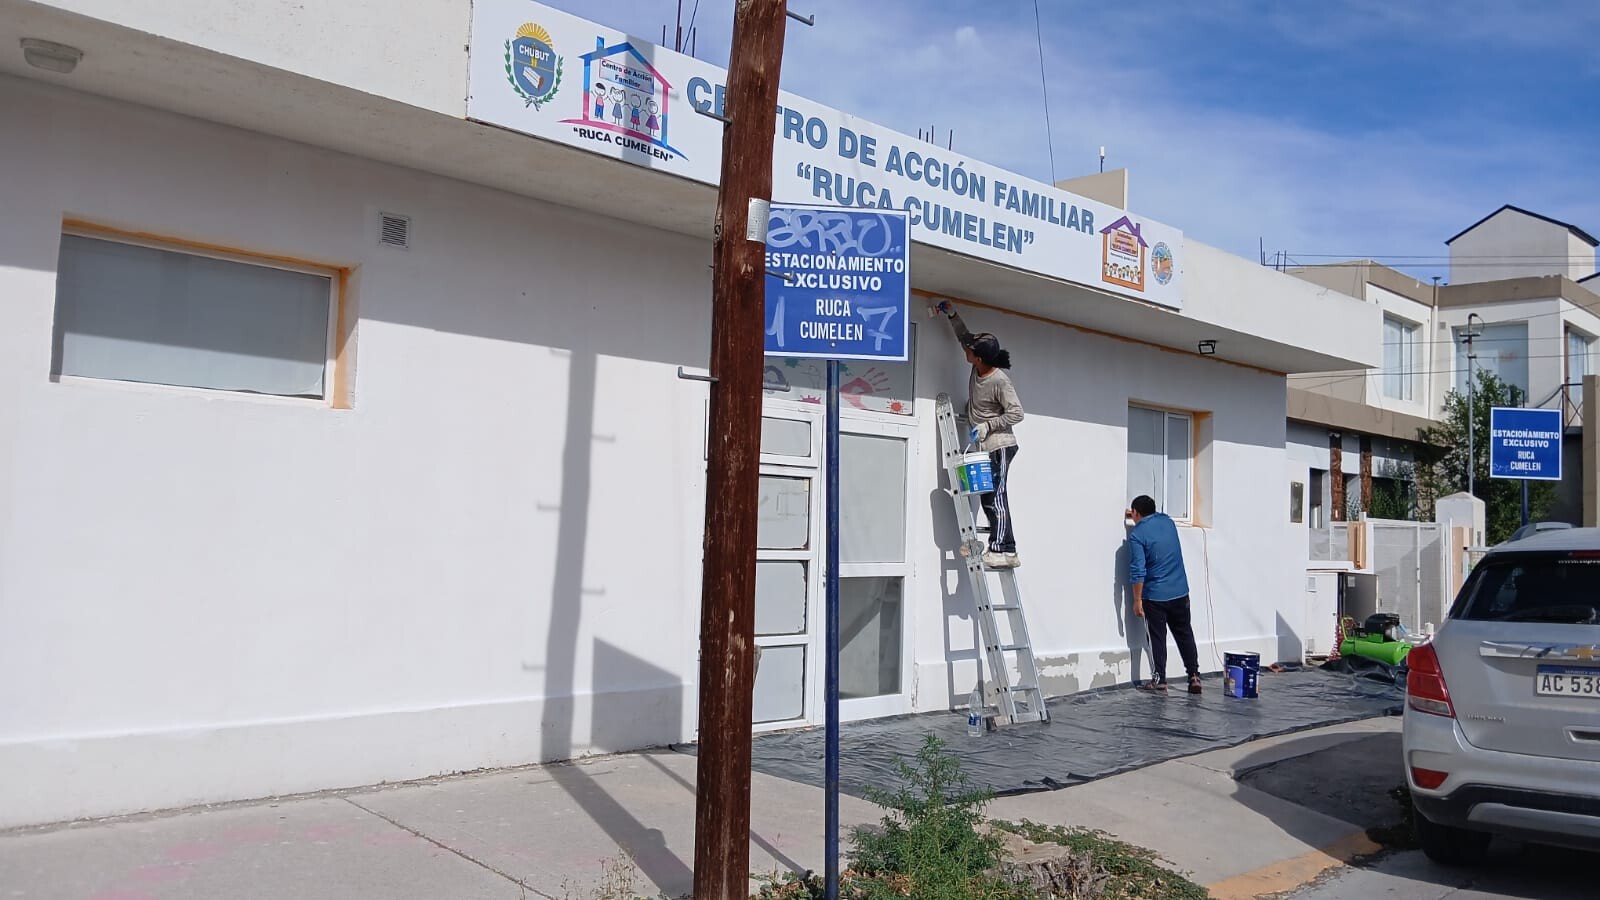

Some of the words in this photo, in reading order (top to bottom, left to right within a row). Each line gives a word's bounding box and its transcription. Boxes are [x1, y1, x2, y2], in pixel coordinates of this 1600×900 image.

[519, 44, 550, 61] CHUBUT
[601, 60, 623, 72] Centro
[624, 67, 632, 75] de
[686, 76, 828, 149] CERO
[838, 127, 877, 167] DE
[885, 145, 985, 202] ACCIÓN
[994, 180, 1095, 235] FAMILIAR
[764, 252, 905, 274] ESTACIONAMIENTO
[783, 272, 883, 291] EXCLUSIVO
[815, 299, 852, 317] RUCA
[799, 321, 863, 341] CUMELEN
[1493, 429, 1560, 440] ESTACIONAMIENTO
[1503, 439, 1549, 448] EXCLUSIVO
[1517, 450, 1535, 460] RUCA
[1510, 461, 1541, 471] CUMELEN
[1541, 674, 1564, 692] AC
